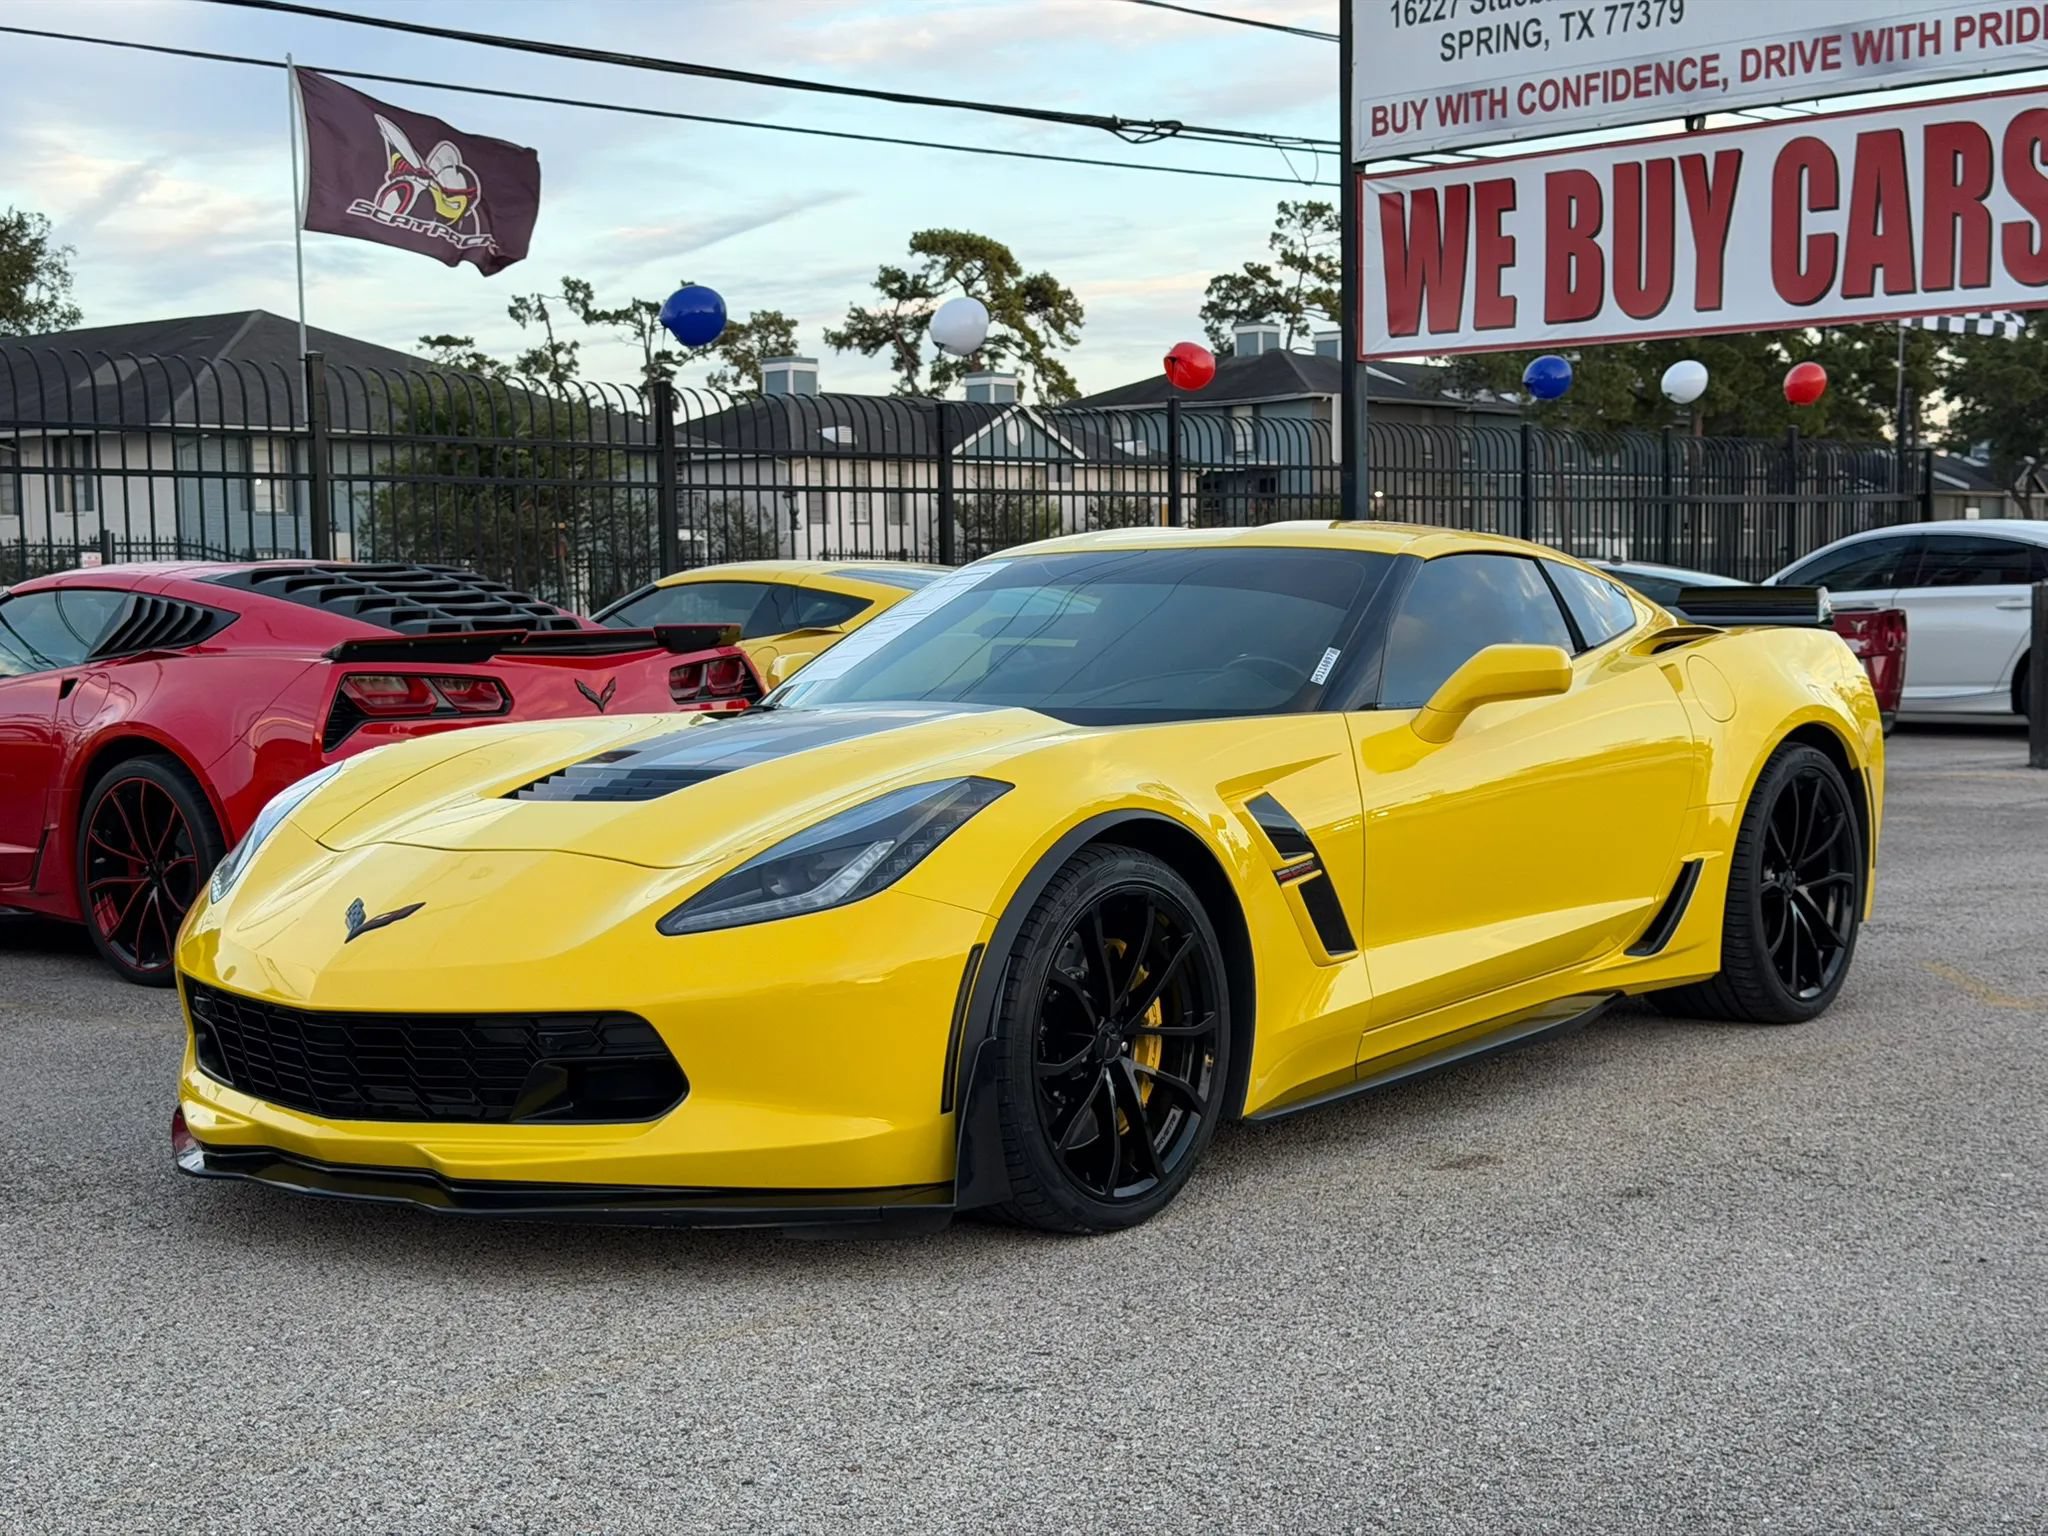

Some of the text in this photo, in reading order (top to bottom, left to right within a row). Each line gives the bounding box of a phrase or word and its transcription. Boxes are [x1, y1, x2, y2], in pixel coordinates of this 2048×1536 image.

[1390, 0, 1458, 28] 16227
[1440, 0, 1685, 62] SPRING, TX 77379
[1371, 4, 2048, 137] BUY WITH CONFIDENCE, DRIVE WITH PRID
[1378, 107, 2048, 338] WE BUY CARS
